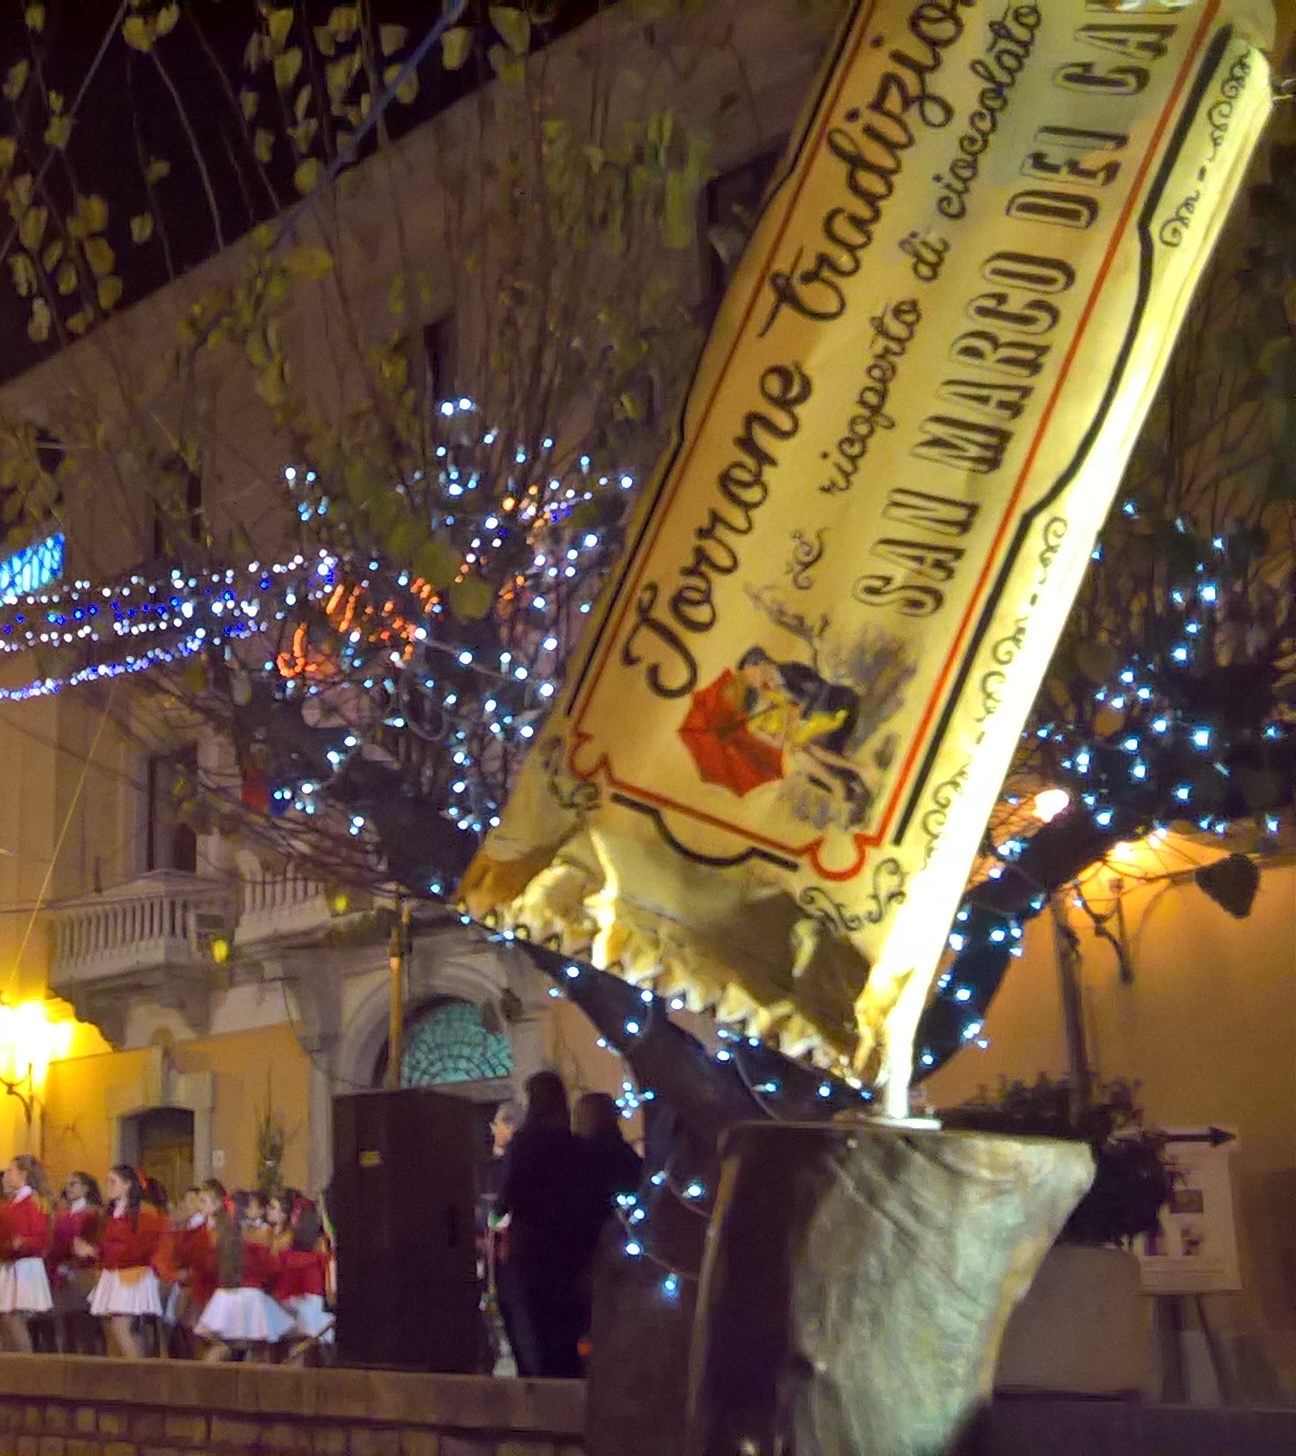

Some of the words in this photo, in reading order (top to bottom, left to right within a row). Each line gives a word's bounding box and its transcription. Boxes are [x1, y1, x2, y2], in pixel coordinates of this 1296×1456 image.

[1051, 0, 1195, 97] CA
[819, 298, 923, 497] ricoperto
[897, 233, 951, 283] di
[937, 0, 1041, 222] cioccolato
[1005, 124, 1130, 230] DEI
[620, 363, 813, 698] Torrone
[758, 0, 975, 338] tradizio
[910, 250, 1077, 475] MARCO
[851, 488, 983, 618] SAN
